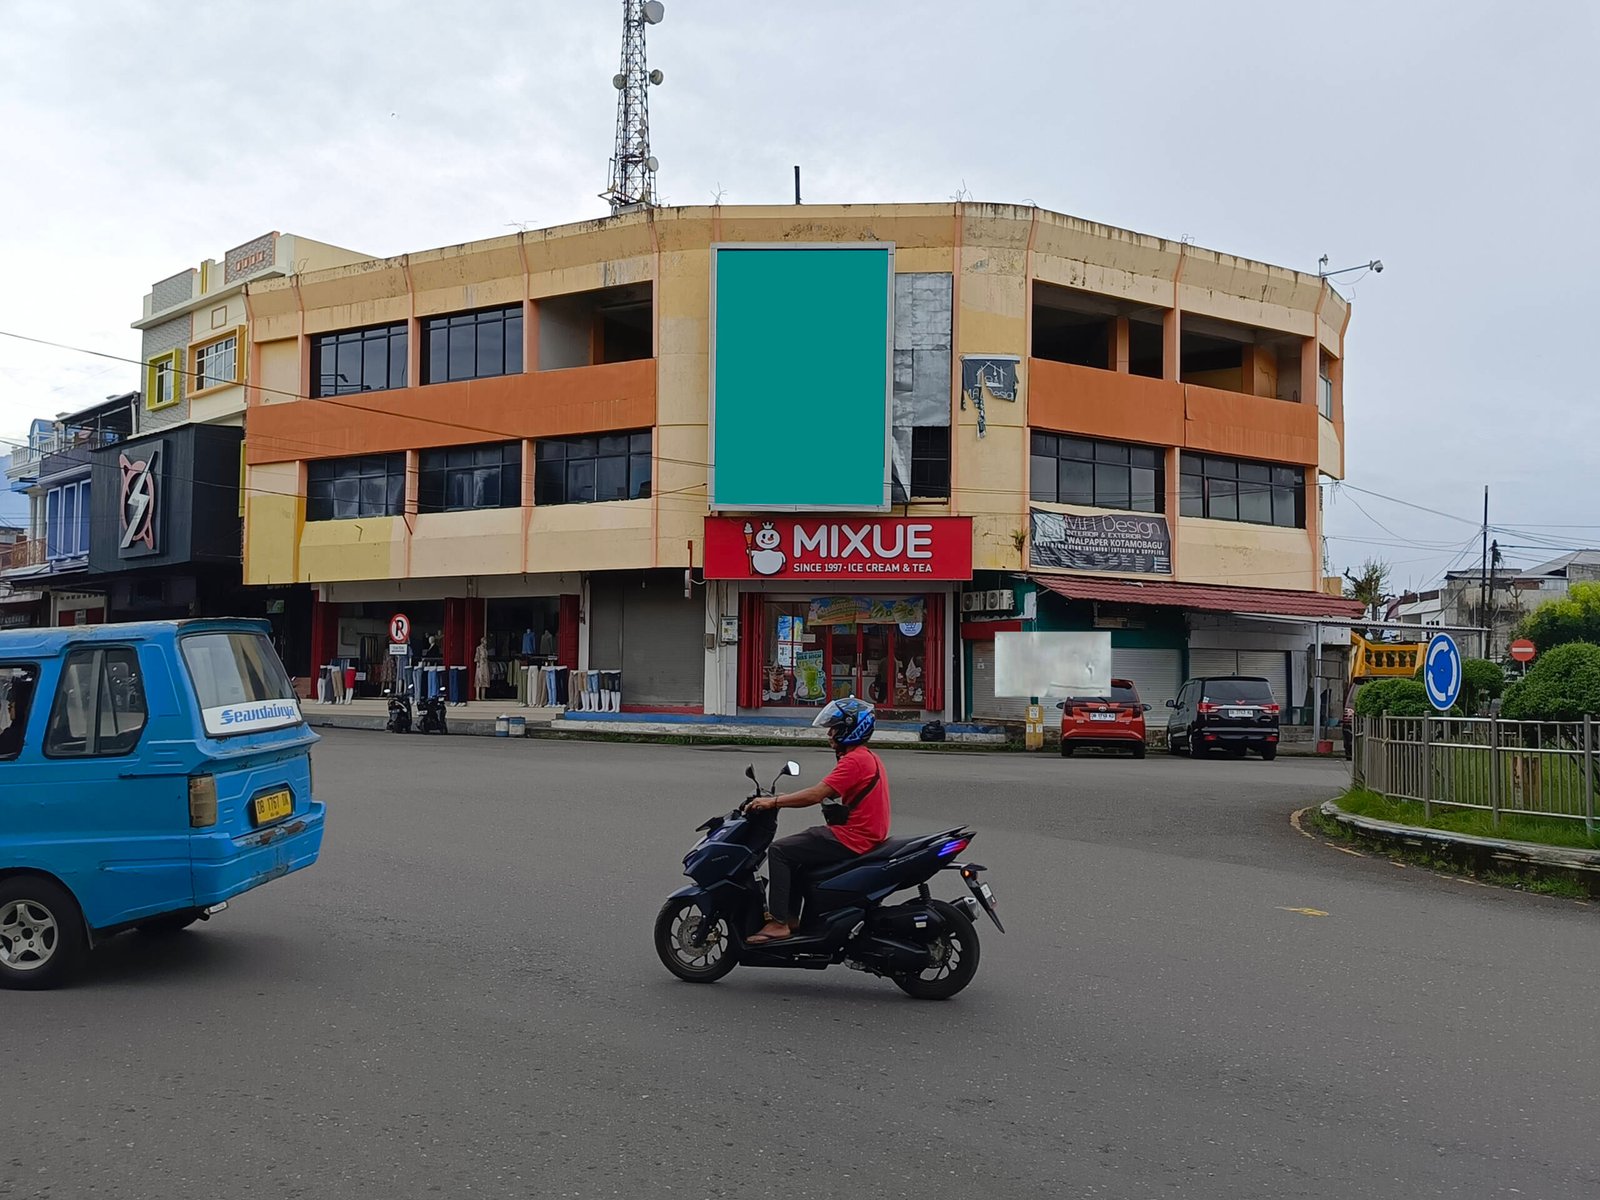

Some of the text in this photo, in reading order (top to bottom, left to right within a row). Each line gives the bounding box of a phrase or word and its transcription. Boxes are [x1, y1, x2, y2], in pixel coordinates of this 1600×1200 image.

[1103, 515, 1161, 538] Design
[793, 524, 933, 558] MIXUE
[1066, 530, 1098, 538] INTERIOR
[1067, 537, 1109, 547] WALPAPER
[1110, 539, 1163, 549] KOTAMOBAGU
[793, 563, 933, 572] SINCE 1997 ICE CREAM & TEA
[256, 799, 266, 815] DB
